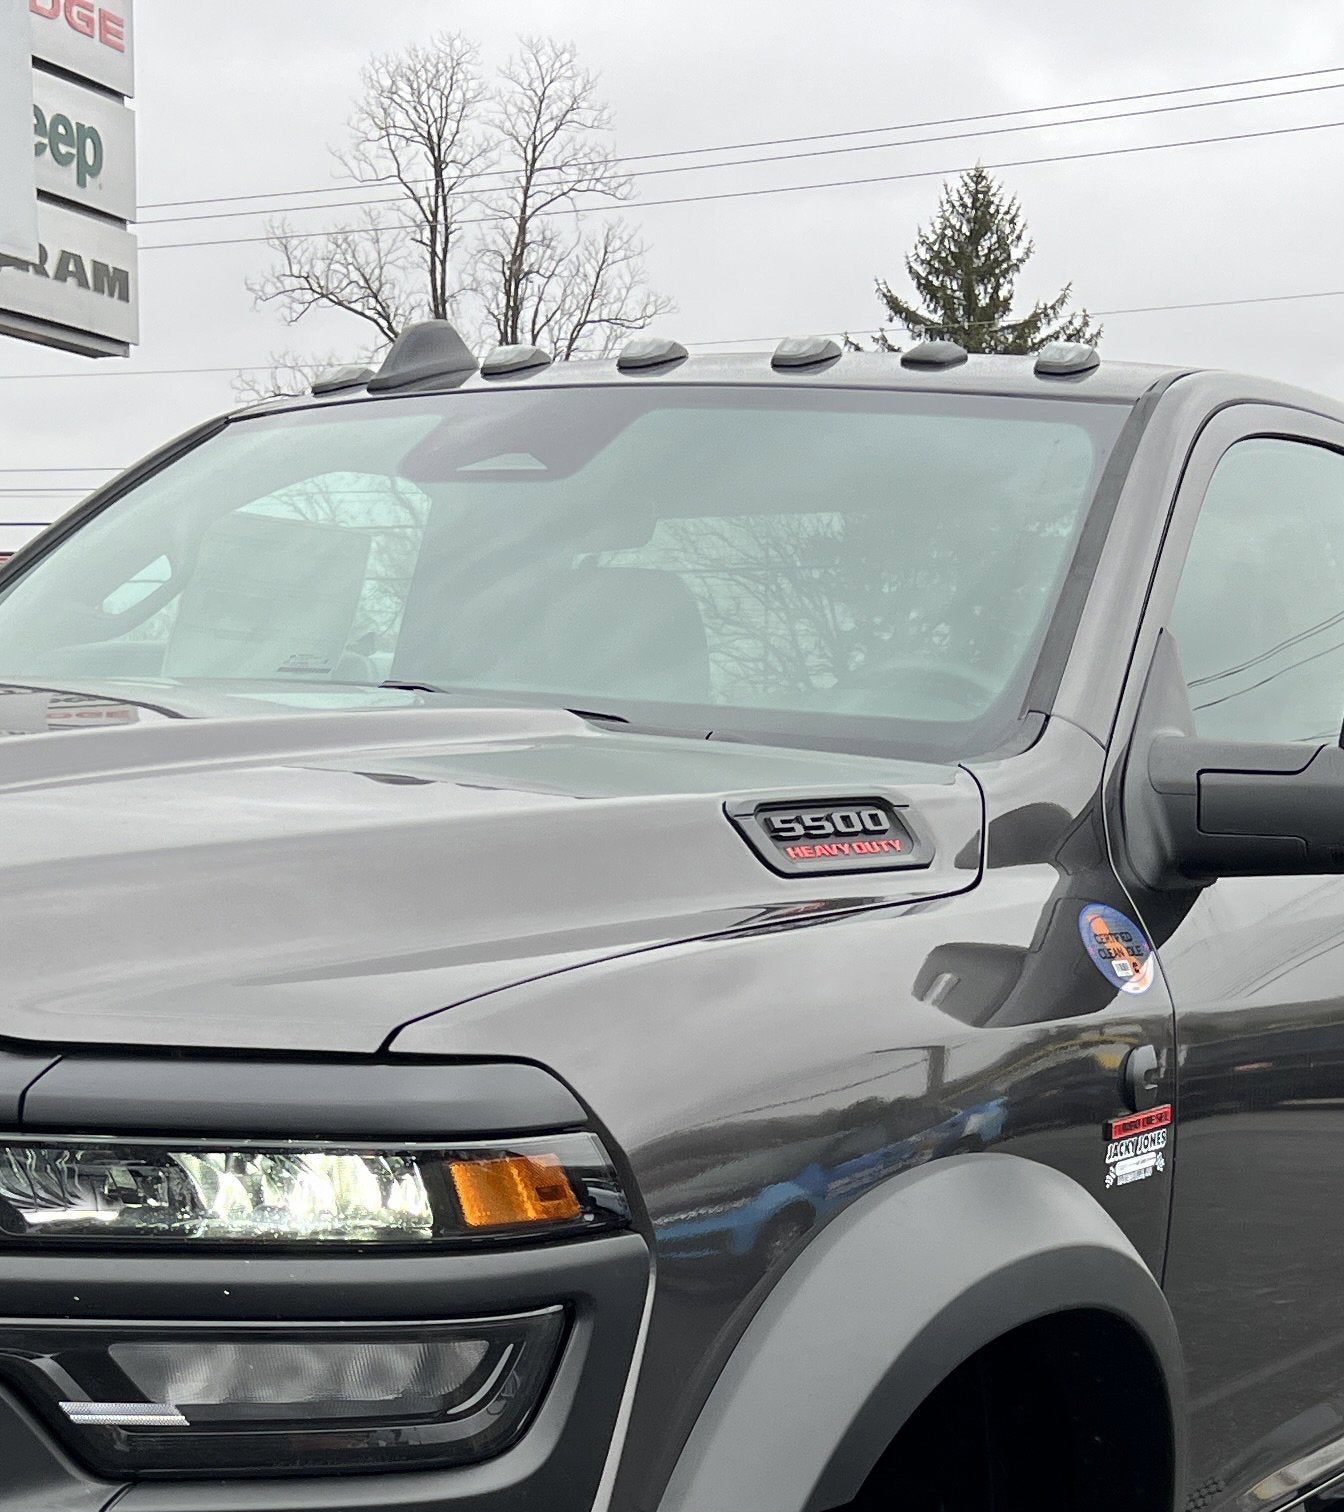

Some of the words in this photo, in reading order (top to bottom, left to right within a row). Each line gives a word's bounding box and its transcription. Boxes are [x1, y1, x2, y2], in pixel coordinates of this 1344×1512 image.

[765, 809, 891, 841] 5500
[786, 842, 849, 860] HEAVY
[855, 839, 902, 855] DUTY
[1098, 947, 1125, 959] CLEAN
[1105, 1136, 1137, 1163] JACKY
[1136, 1128, 1167, 1154] JONES
